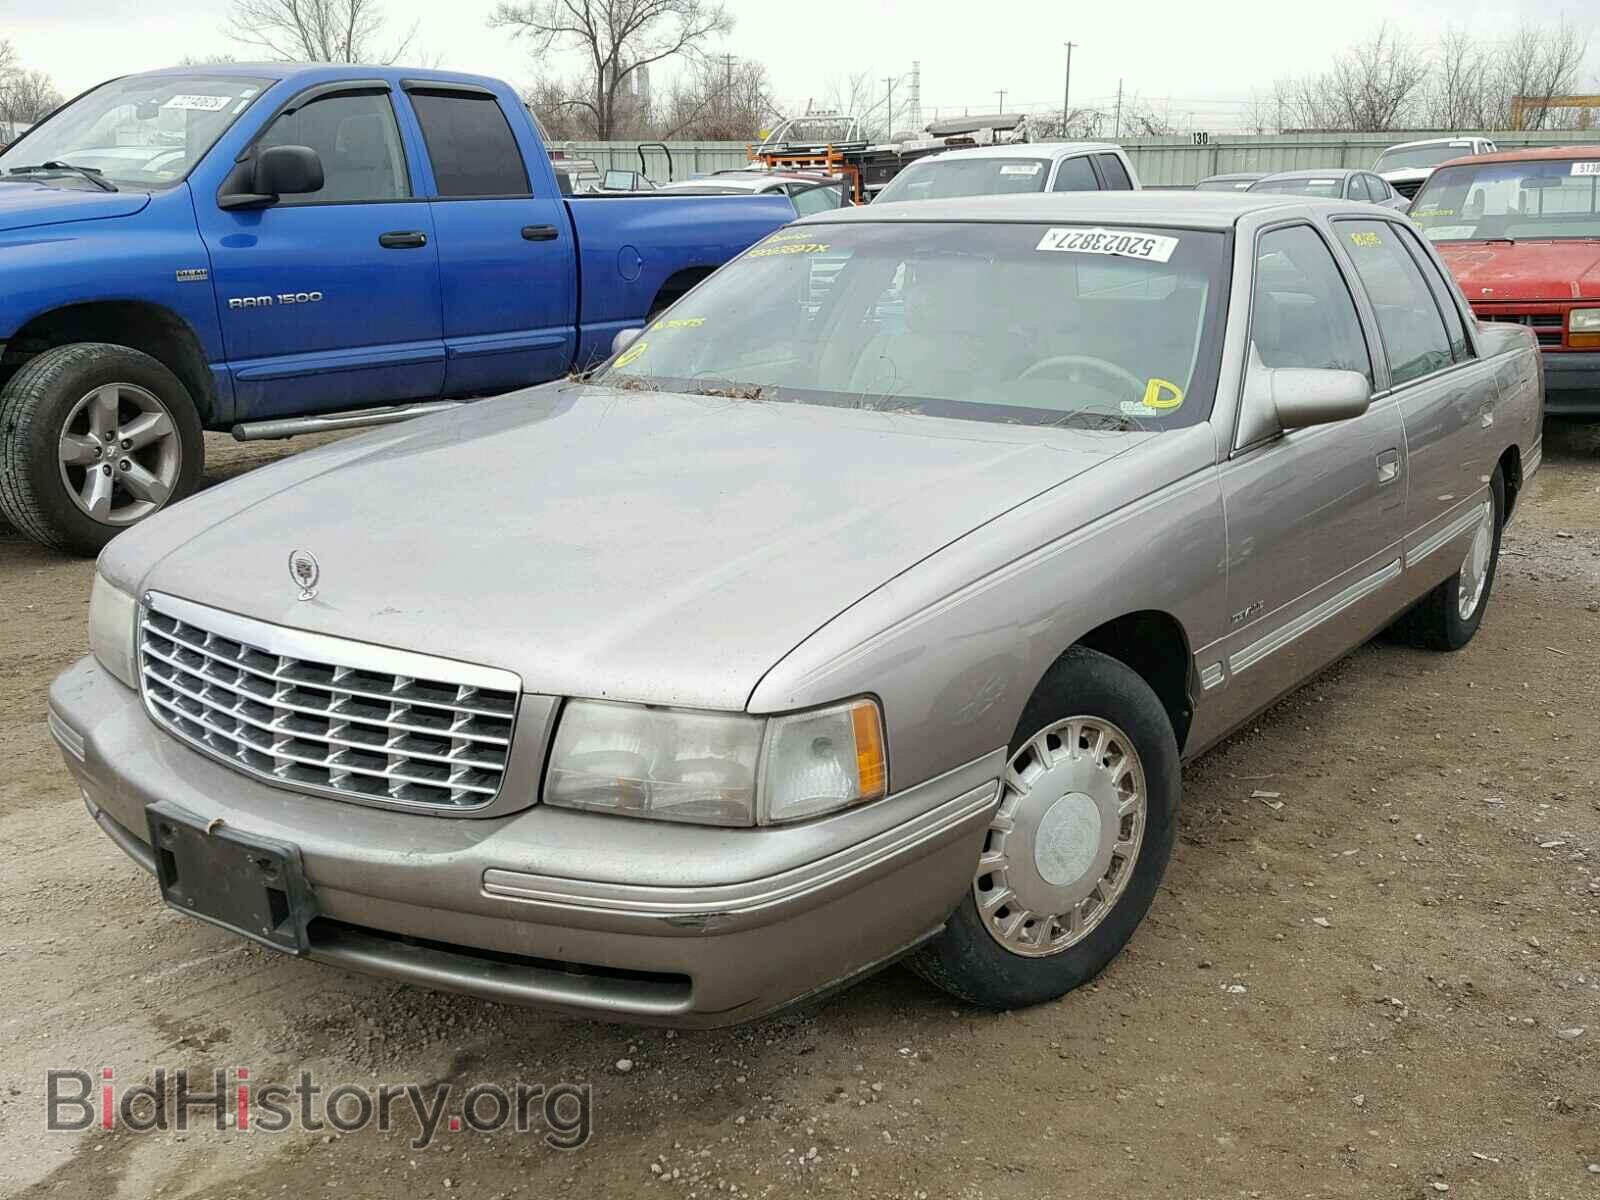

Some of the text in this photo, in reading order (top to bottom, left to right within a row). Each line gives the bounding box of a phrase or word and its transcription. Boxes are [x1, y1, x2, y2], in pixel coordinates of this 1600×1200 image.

[1193, 132, 1208, 145] 130
[228, 291, 323, 310] RAM 1500
[1143, 378, 1185, 408] D
